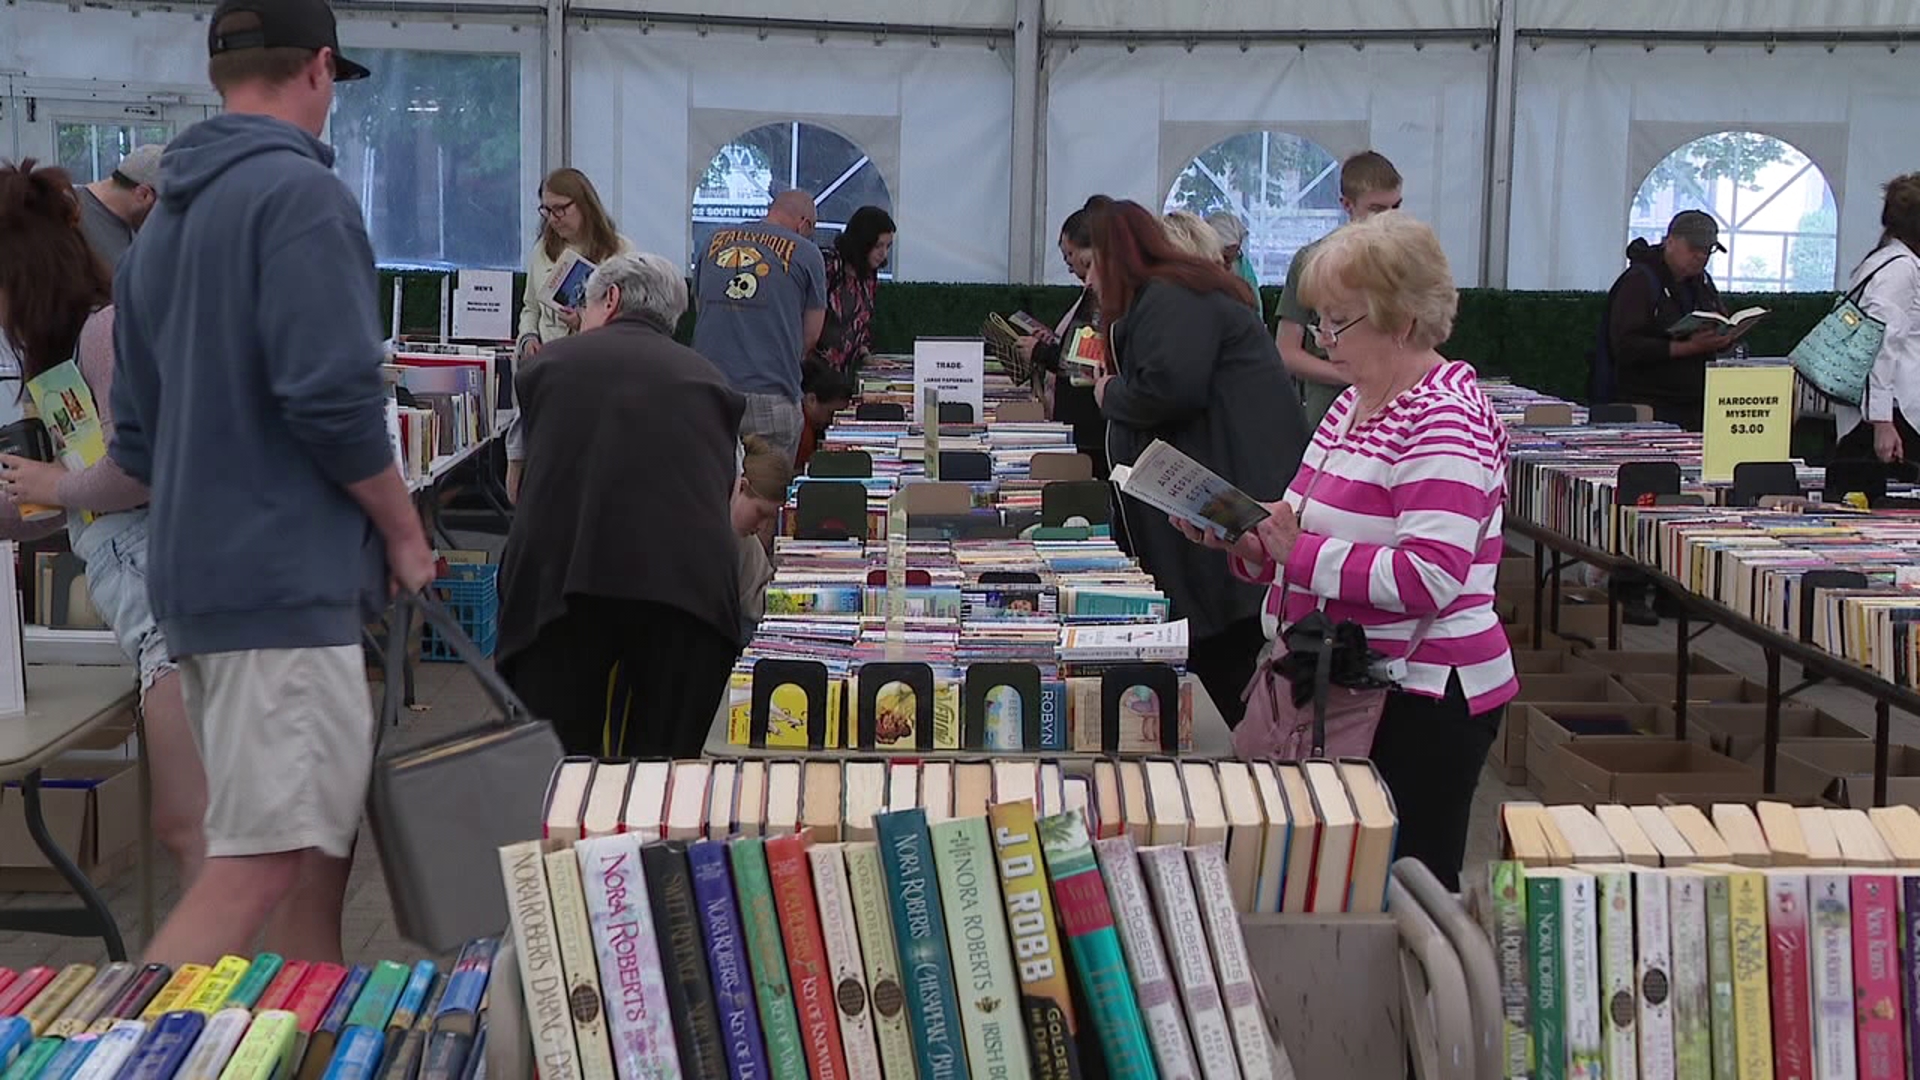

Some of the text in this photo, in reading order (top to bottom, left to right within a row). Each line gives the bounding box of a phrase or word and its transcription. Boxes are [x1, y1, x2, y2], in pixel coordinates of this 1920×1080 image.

[706, 206, 740, 217] SOUTH
[1718, 396, 1779, 406] HARDCOVER
[1726, 409, 1771, 418] MYSTERY
[1730, 424, 1764, 434] $3.00
[1157, 459, 1186, 487] AUDREY
[1040, 690, 1055, 746] ROBYN
[510, 851, 544, 906] NORA
[894, 832, 923, 877] NORA
[599, 851, 636, 917] NORA
[660, 872, 690, 920] SWEET
[814, 852, 849, 965] NORA ROBERTS
[853, 853, 884, 966] NORA ROBERTS
[897, 877, 933, 940] ROBERTS
[953, 857, 980, 911] NORA
[517, 900, 555, 972] ROBERTS
[705, 896, 732, 935] NORA
[1007, 887, 1056, 985] ROBB
[1113, 855, 1138, 903] NORA
[1128, 905, 1160, 979] ROBERTS
[1163, 859, 1190, 907] NORA
[1177, 909, 1211, 985] ROBERTS
[1203, 854, 1228, 902] NORA
[1216, 905, 1247, 981] ROBERTS
[1537, 912, 1554, 953] NORA
[1570, 907, 1587, 948] NORA
[668, 921, 702, 985] REVENGE
[708, 934, 742, 989] ROBERTS
[961, 913, 993, 991] ROBERTS
[1500, 934, 1523, 980] ROBERTS
[1734, 916, 1753, 982] ROBERTS
[1747, 923, 1763, 974] NORA
[1823, 925, 1843, 997] NORA ROBERTS
[1866, 906, 1892, 980] NORA ROBERTS
[605, 919, 654, 1023] ROBERTS
[800, 975, 819, 1002] KEY
[1536, 955, 1554, 1009] ROBERTS
[1572, 948, 1588, 1003] ROBERTS
[530, 975, 568, 1044] DARING
[727, 1009, 749, 1038] KEY
[769, 998, 788, 1023] KEY
[806, 1003, 822, 1021] OF
[914, 960, 951, 1044] CHESAPEAKE
[1030, 1007, 1040, 1023] IN
[1507, 1005, 1525, 1022] THE
[733, 1039, 751, 1060] OF
[980, 1021, 1005, 1066] IRISH
[1045, 1006, 1070, 1080] GOLDEN
[1507, 1028, 1529, 1076] WITNESS
